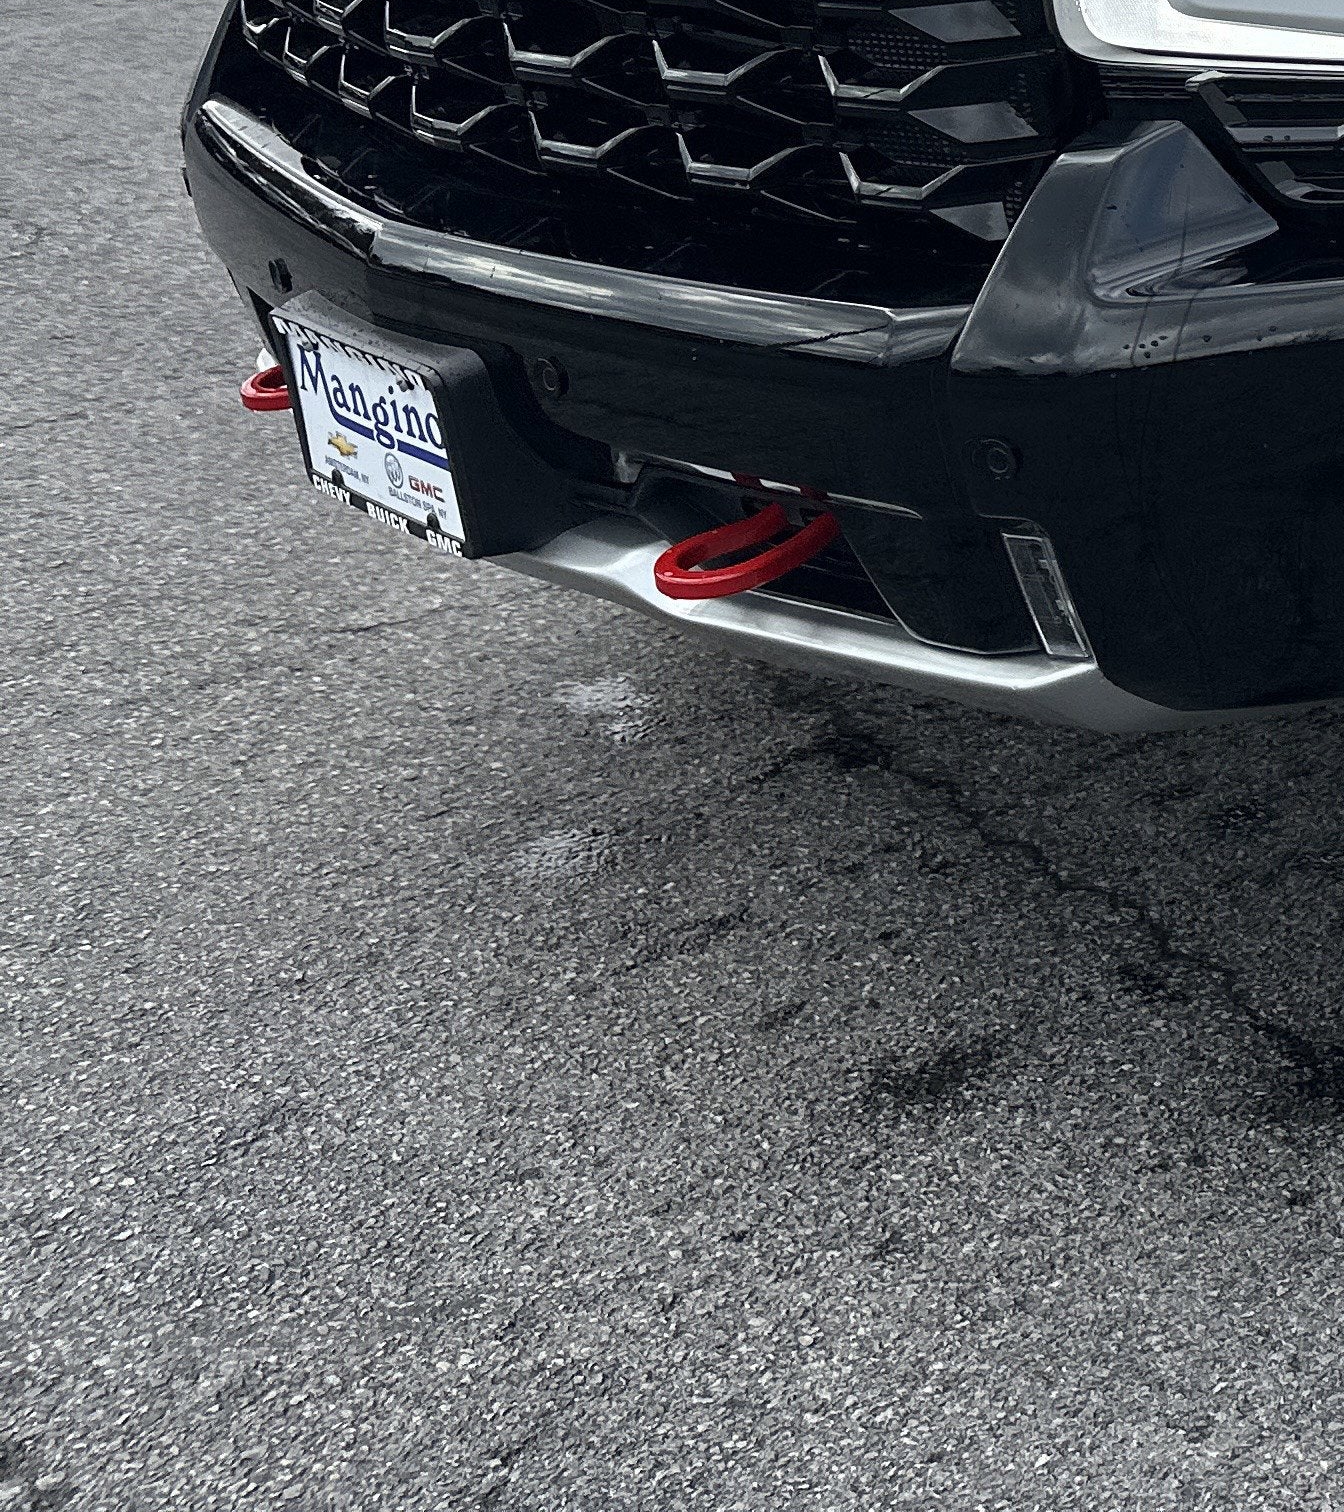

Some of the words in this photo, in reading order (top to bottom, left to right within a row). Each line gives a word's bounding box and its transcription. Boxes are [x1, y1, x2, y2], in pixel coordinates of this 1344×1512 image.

[297, 343, 447, 450] Mangino
[312, 474, 351, 507] CHEVY
[365, 501, 410, 535] BUICK
[425, 528, 463, 557] GMC
[408, 475, 446, 504] GMC
